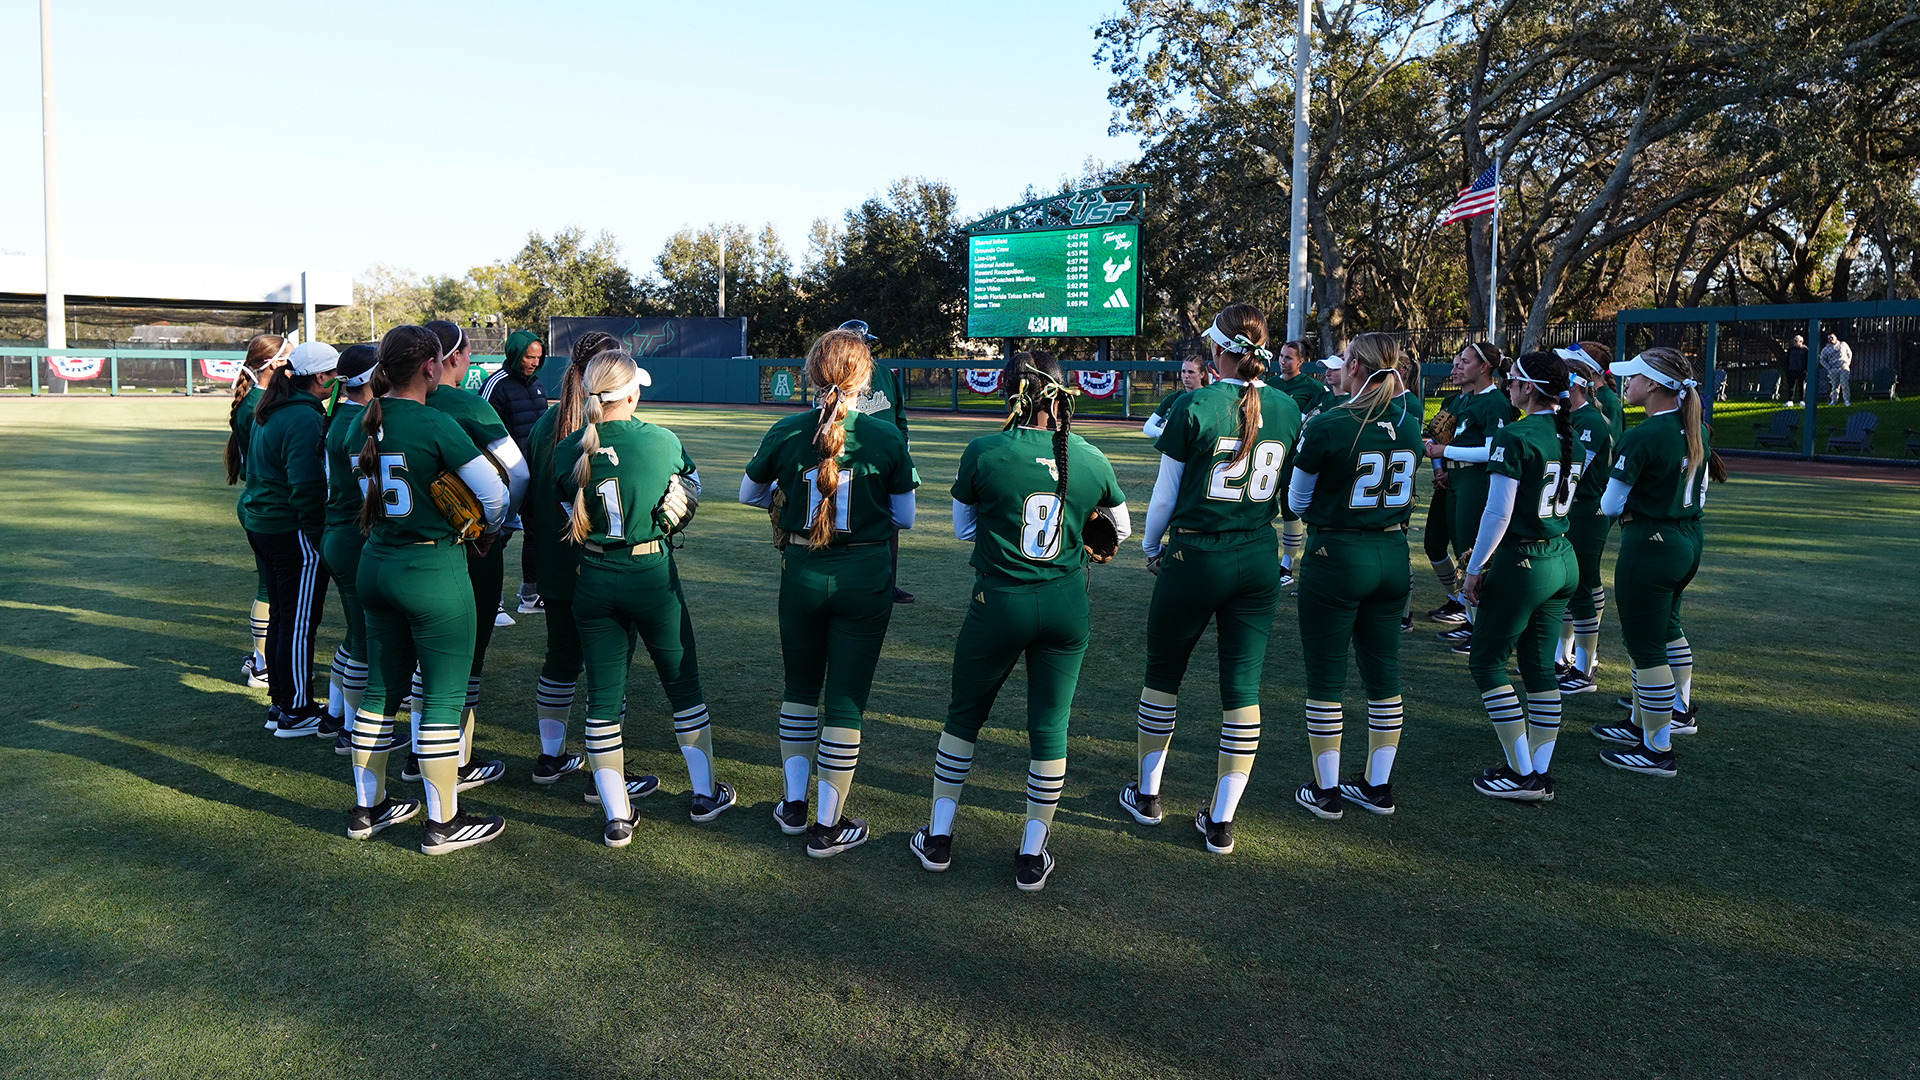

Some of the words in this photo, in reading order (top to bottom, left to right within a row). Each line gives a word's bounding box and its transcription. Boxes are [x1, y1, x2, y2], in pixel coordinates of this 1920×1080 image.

[1068, 189, 1134, 226] USF
[1079, 240, 1089, 248] PM
[994, 268, 1025, 276] Recognition
[1015, 275, 1036, 283] Meeting
[1028, 316, 1050, 333] 4:34
[1050, 316, 1068, 333] PM
[466, 369, 482, 389] A
[775, 374, 791, 396] A
[856, 390, 891, 416] Bulls
[1207, 437, 1286, 502] 28
[1349, 449, 1416, 509] 23
[595, 477, 625, 540] 1
[1020, 491, 1063, 561] 8
